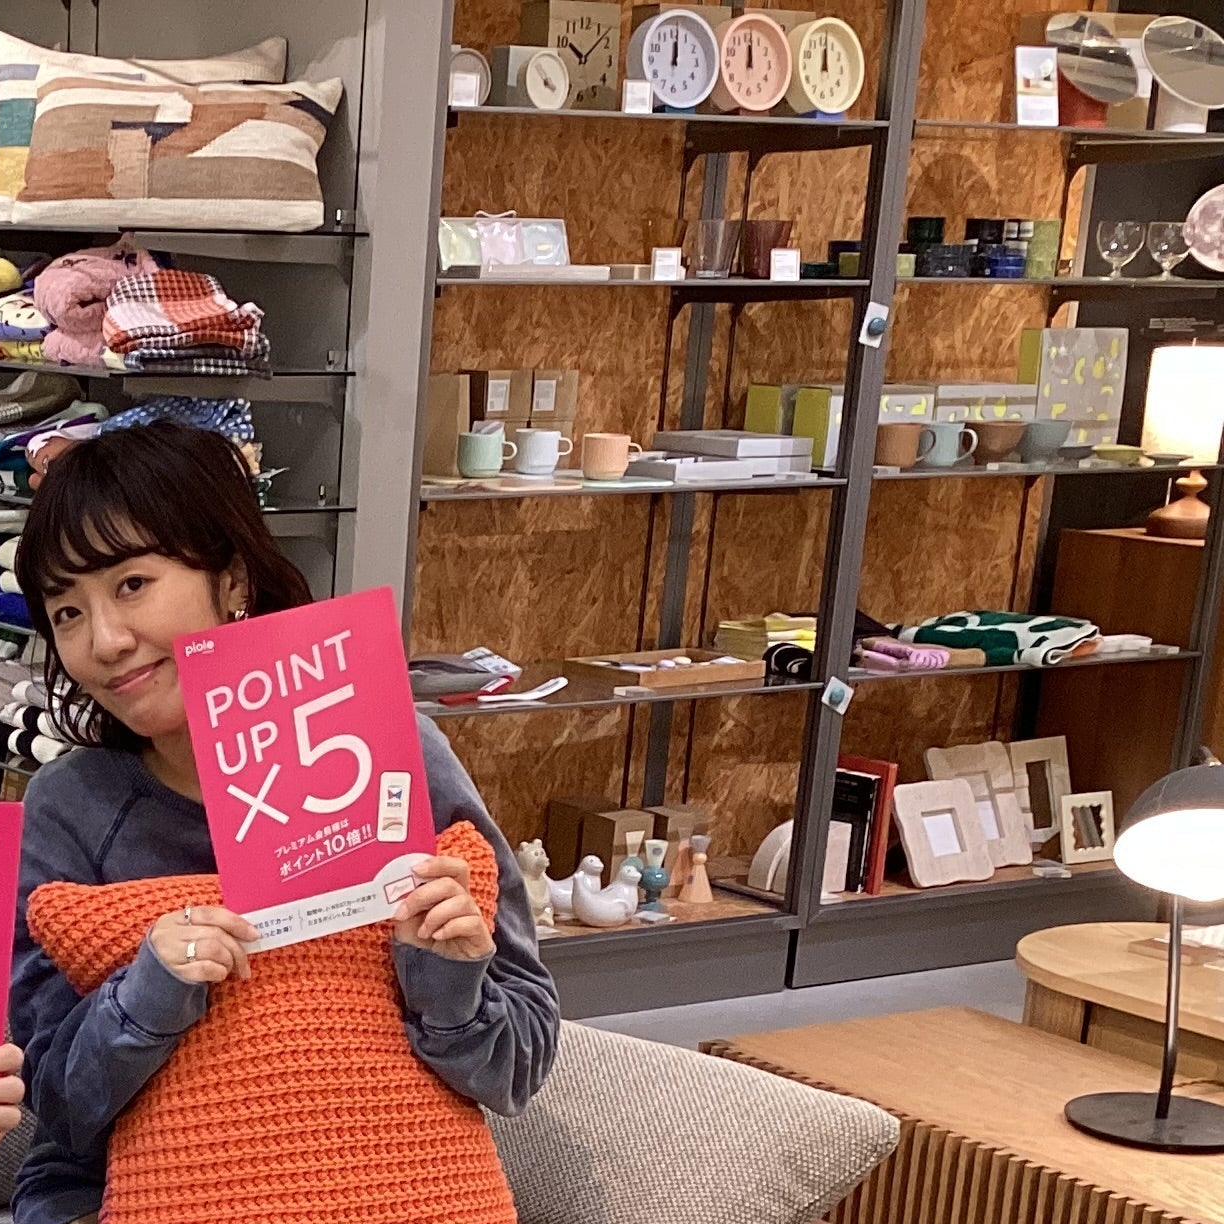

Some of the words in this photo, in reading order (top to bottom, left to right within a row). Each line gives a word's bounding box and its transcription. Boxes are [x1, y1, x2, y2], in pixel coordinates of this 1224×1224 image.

[566, 20, 576, 34] 11
[580, 16, 592, 30] 12
[597, 23, 601, 36] 1
[557, 35, 568, 48] 10
[658, 32, 666, 42] 11
[684, 33, 688, 43] 1
[733, 36, 741, 46] 11
[757, 37, 761, 47] 1
[604, 37, 610, 49] 2
[650, 43, 660, 53] 10
[691, 45, 696, 54] 2
[726, 47, 736, 57] 10
[763, 46, 768, 57] 2
[607, 55, 612, 68] 3
[648, 56, 654, 65] 9
[694, 58, 699, 68] 3
[725, 60, 730, 69] 9
[767, 60, 771, 71] 3
[652, 69, 658, 79] 8
[689, 72, 694, 80] 4
[729, 73, 735, 82] 8
[763, 74, 768, 82] 4
[600, 73, 607, 86] 4
[660, 79, 666, 89] 7
[670, 84, 676, 93] 6
[682, 80, 687, 90] 5
[737, 82, 742, 92] 7
[757, 83, 762, 93] 5
[576, 90, 584, 102] 6
[592, 85, 597, 98] 5
[746, 88, 752, 96] 6
[185, 639, 215, 656] piole
[205, 629, 352, 729] POINT
[215, 720, 279, 776] UP
[293, 683, 373, 814] 5
